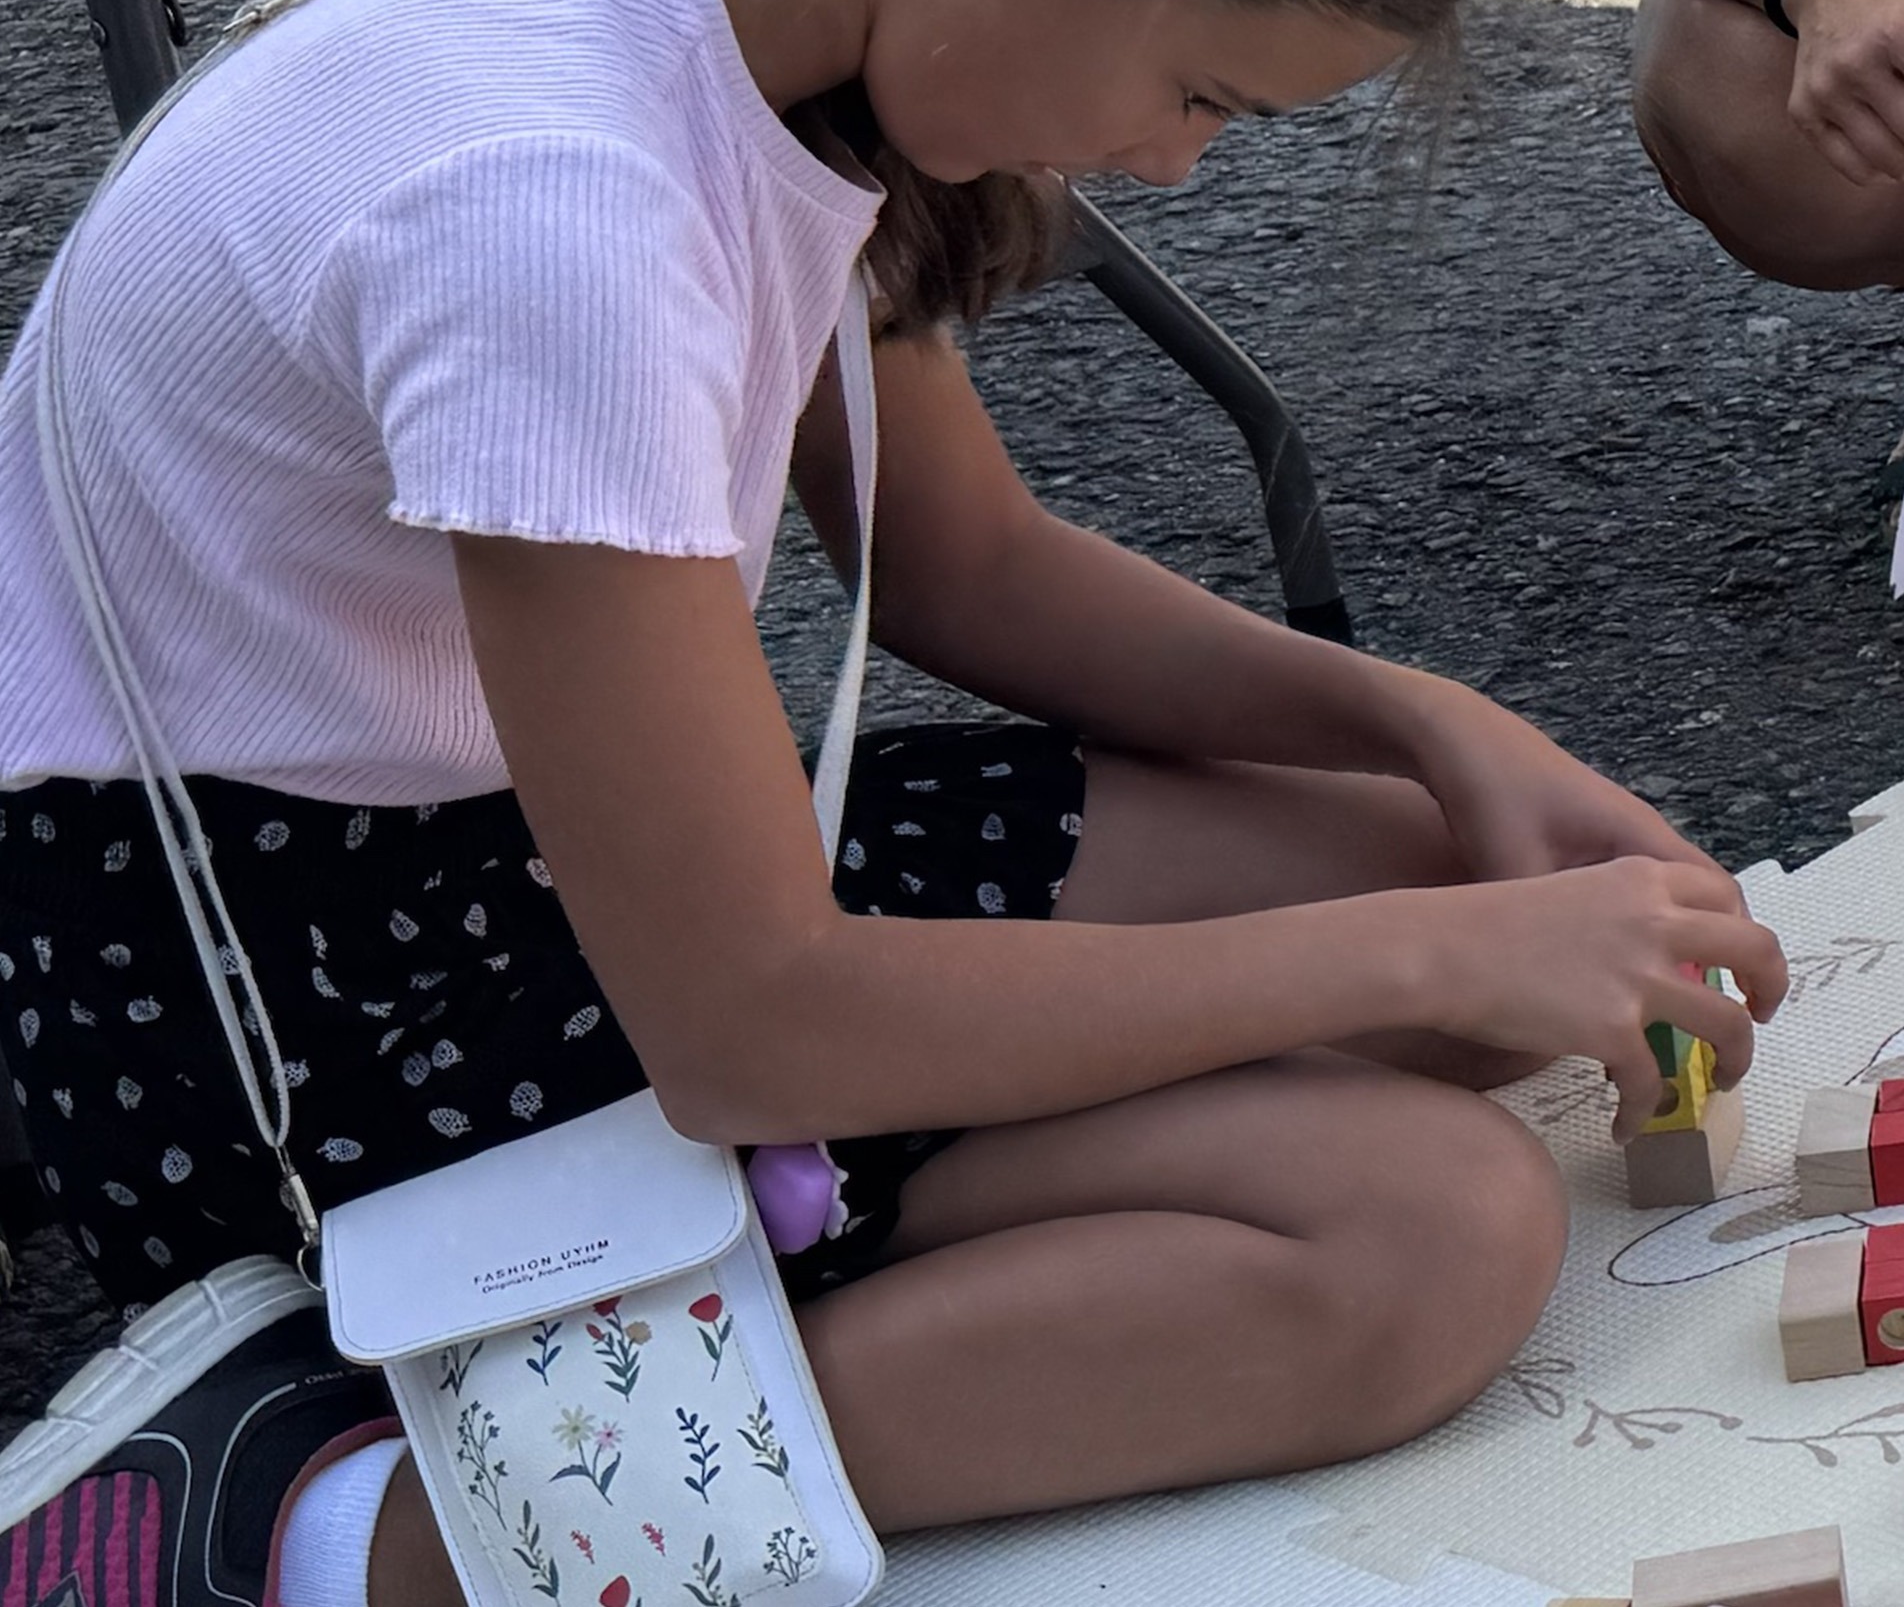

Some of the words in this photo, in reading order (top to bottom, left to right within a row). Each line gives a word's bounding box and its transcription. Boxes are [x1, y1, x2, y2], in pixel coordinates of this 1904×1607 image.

[474, 1256, 551, 1285] FASHION
[482, 1273, 535, 1294] Originally
[567, 1254, 603, 1270] Design
